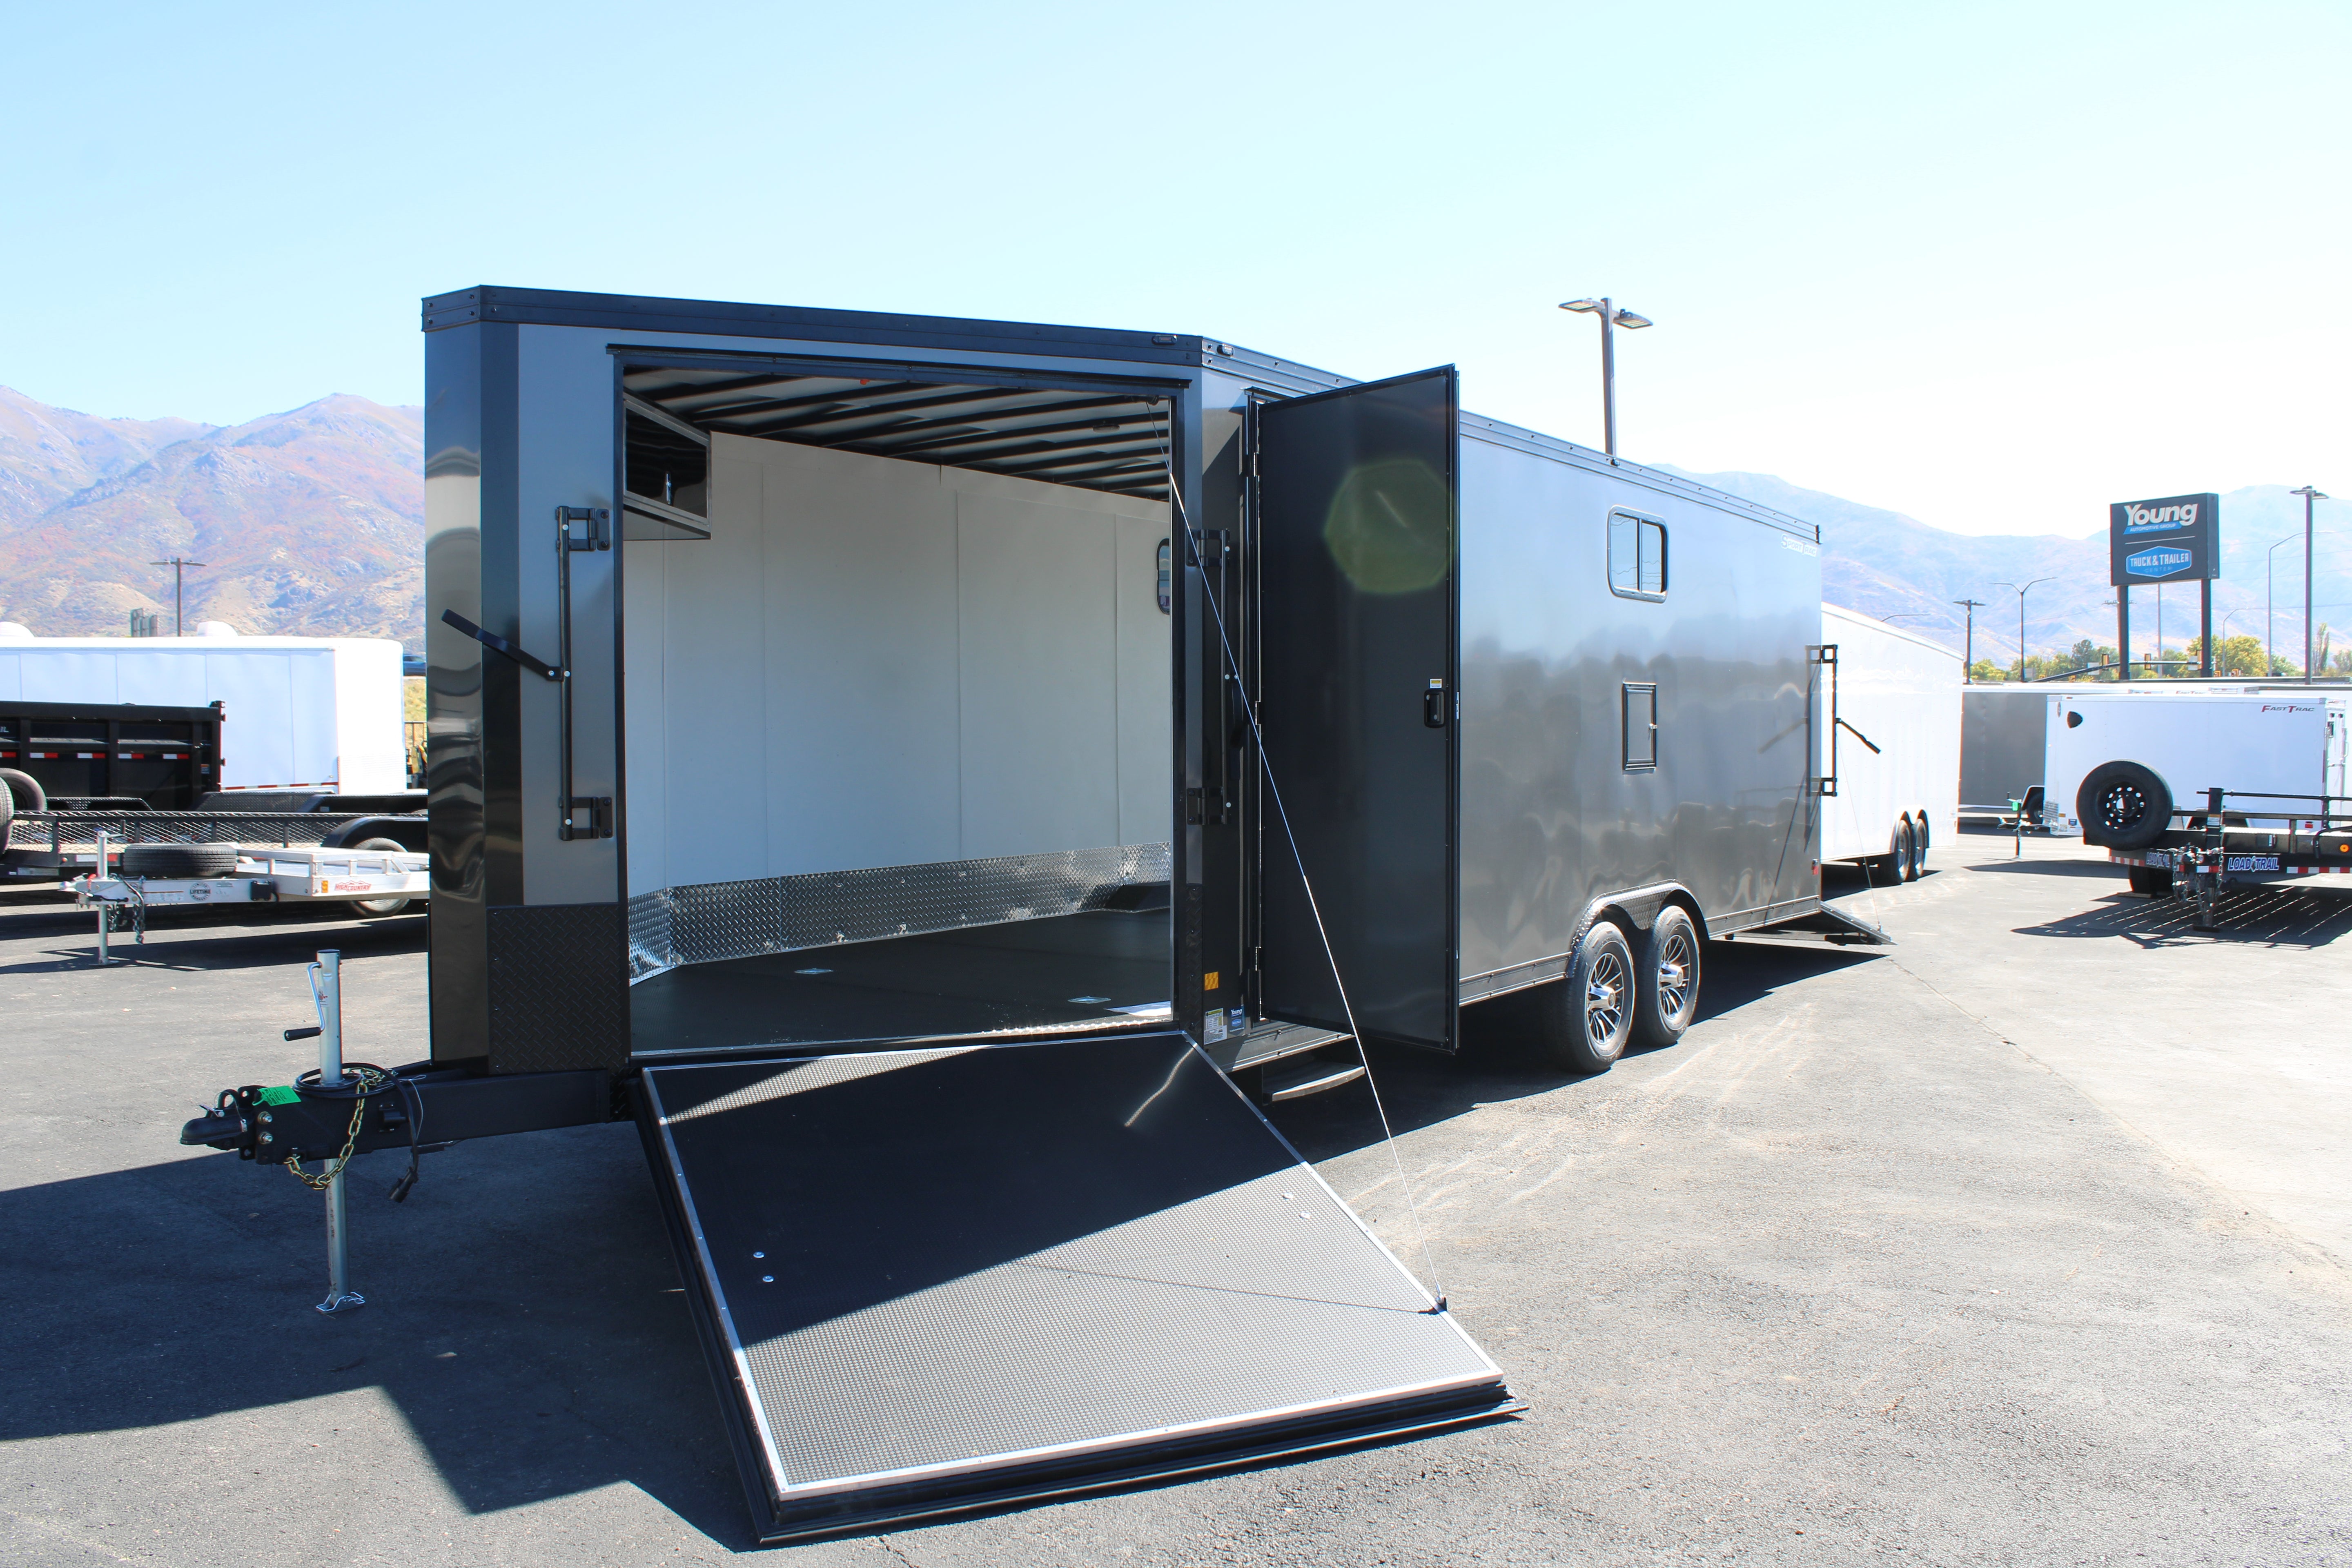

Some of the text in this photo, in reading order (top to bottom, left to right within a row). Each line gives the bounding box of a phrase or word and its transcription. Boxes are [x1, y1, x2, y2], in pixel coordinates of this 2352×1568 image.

[2124, 503, 2198, 526] Young
[2130, 553, 2189, 567] TRUCK & TRAILER
[2146, 852, 2157, 865] LOAD
[2227, 857, 2279, 871] LOAD TRAIL
